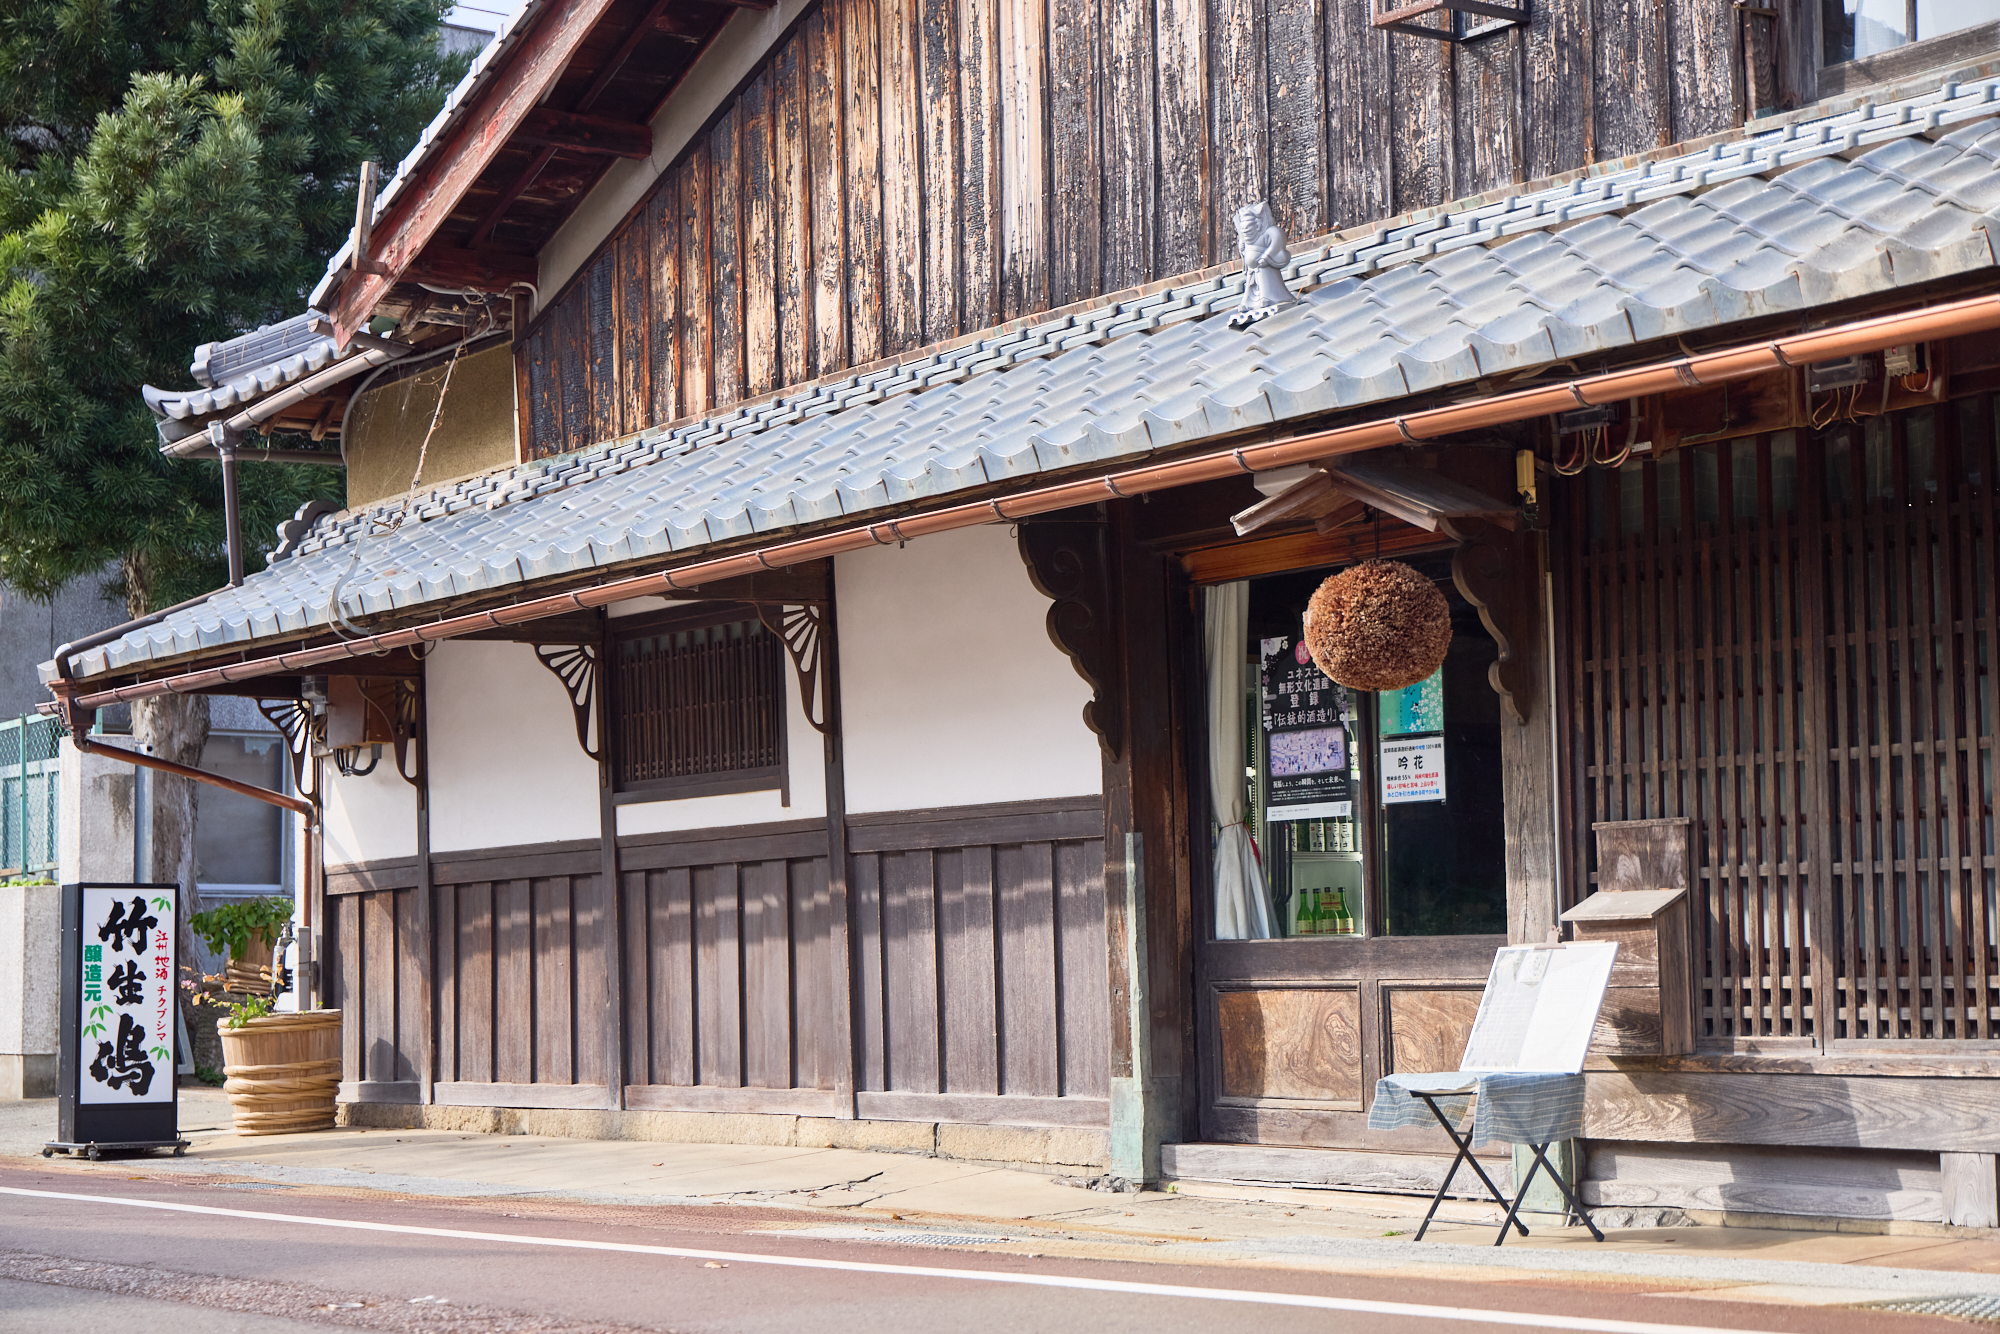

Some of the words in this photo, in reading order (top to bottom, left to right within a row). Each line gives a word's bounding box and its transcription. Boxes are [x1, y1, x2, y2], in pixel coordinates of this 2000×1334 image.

[1278, 677, 1330, 695] 無形文化遺産
[1287, 667, 1320, 679] ユネスコ
[1274, 707, 1337, 727] 「伝統的酒造り」
[155, 929, 170, 980] 江州地酒
[89, 896, 158, 1096] 竹生嶋
[156, 985, 167, 1042] チクブシマ
